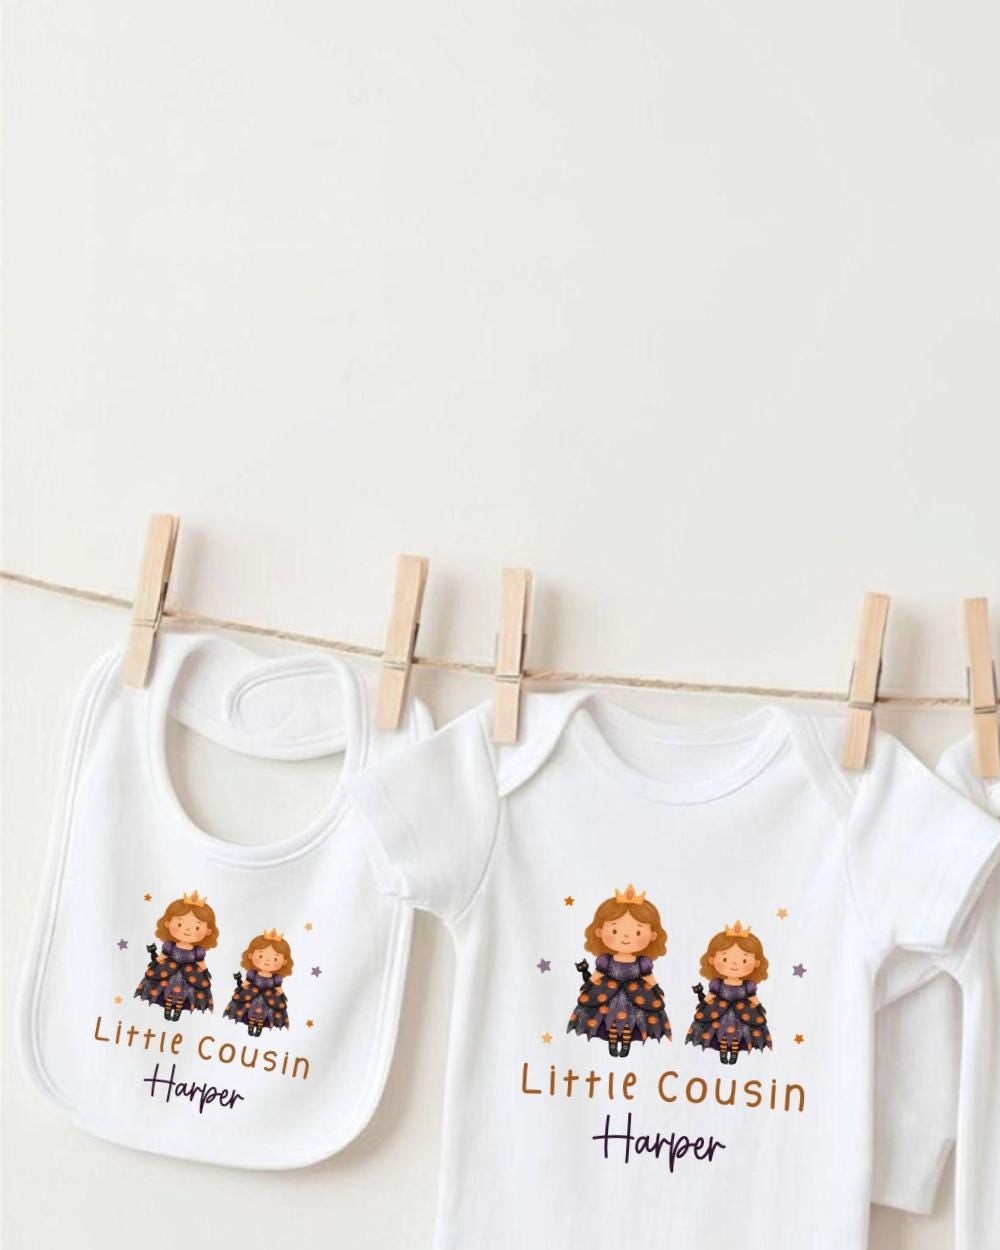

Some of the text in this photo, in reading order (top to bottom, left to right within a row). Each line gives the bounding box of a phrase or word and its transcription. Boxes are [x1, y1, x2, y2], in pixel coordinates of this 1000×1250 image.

[94, 1017, 310, 1079] Little Cousin
[143, 1063, 245, 1114] Harper
[522, 1062, 806, 1111] Little Cousin
[592, 1112, 726, 1174] Harper
